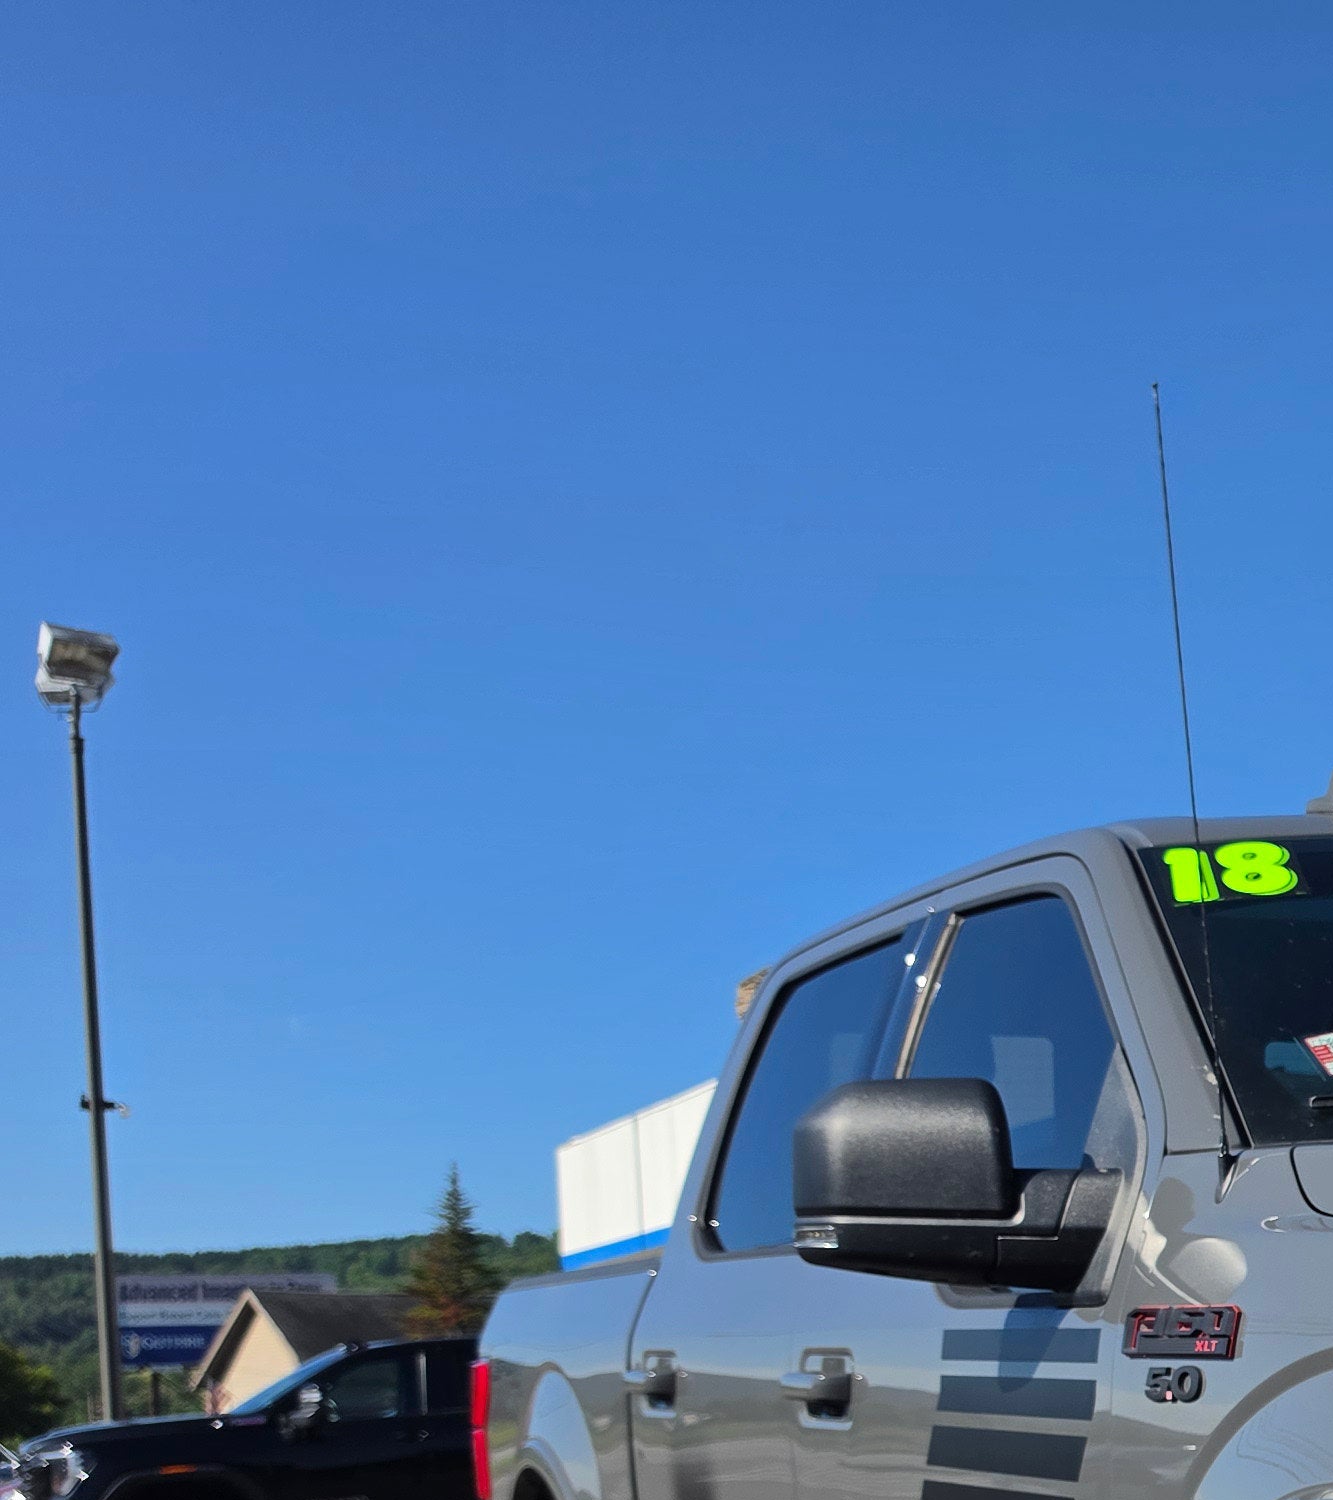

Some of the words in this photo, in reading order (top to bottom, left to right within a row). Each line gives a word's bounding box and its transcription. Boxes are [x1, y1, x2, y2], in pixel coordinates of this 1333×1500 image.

[1163, 841, 1298, 904] 18
[1194, 1340, 1219, 1352] XLT
[1144, 1365, 1203, 1403] 5.0
